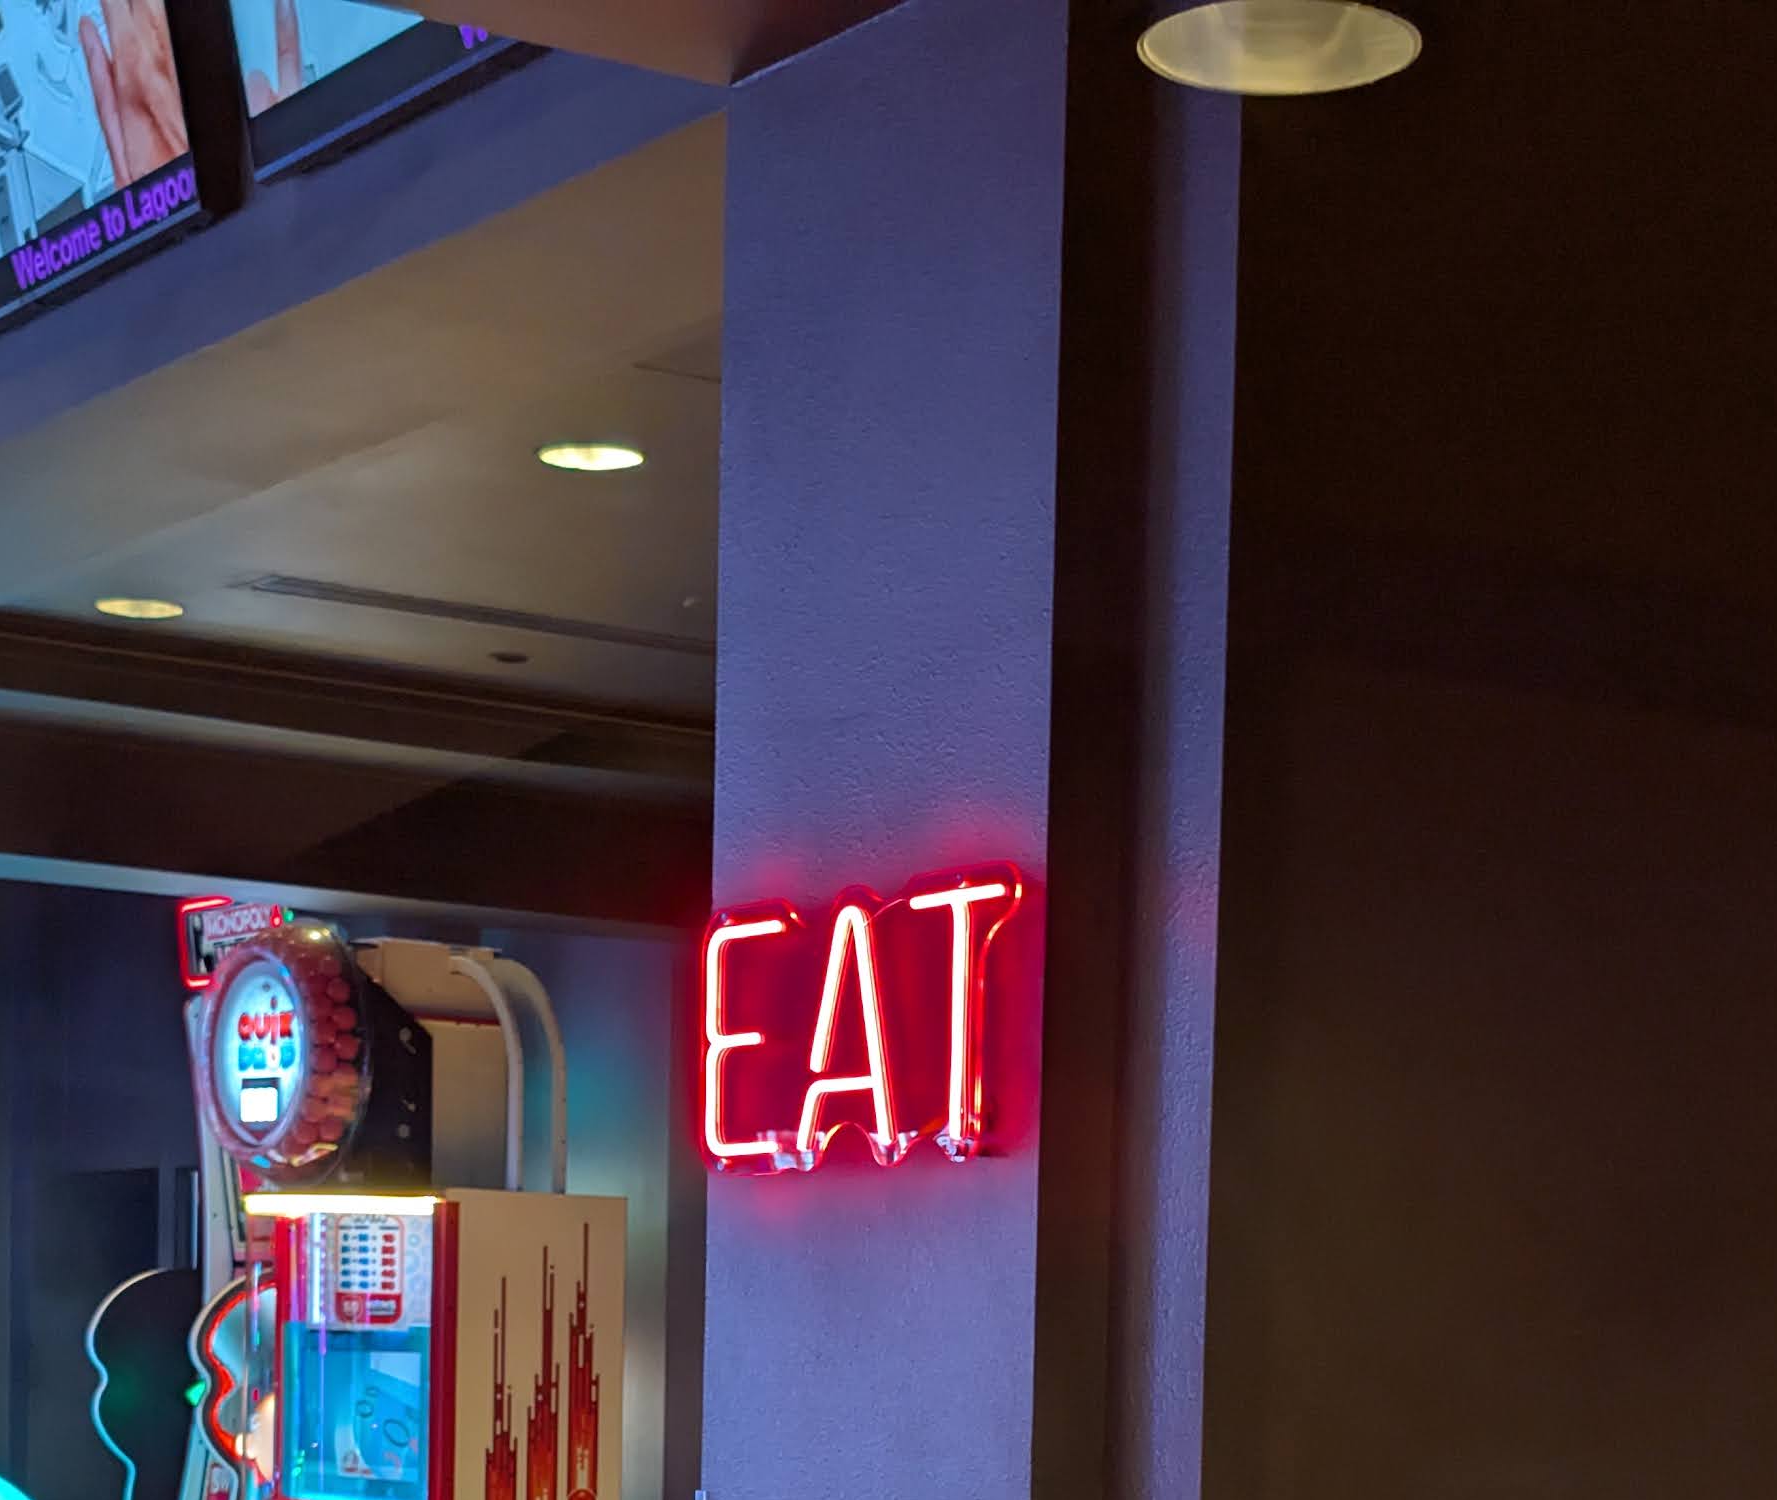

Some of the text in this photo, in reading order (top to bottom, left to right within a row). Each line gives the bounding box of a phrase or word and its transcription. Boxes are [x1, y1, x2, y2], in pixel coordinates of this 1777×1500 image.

[10, 166, 197, 290] Welcome to Lagoo
[704, 878, 1010, 1160] EAT
